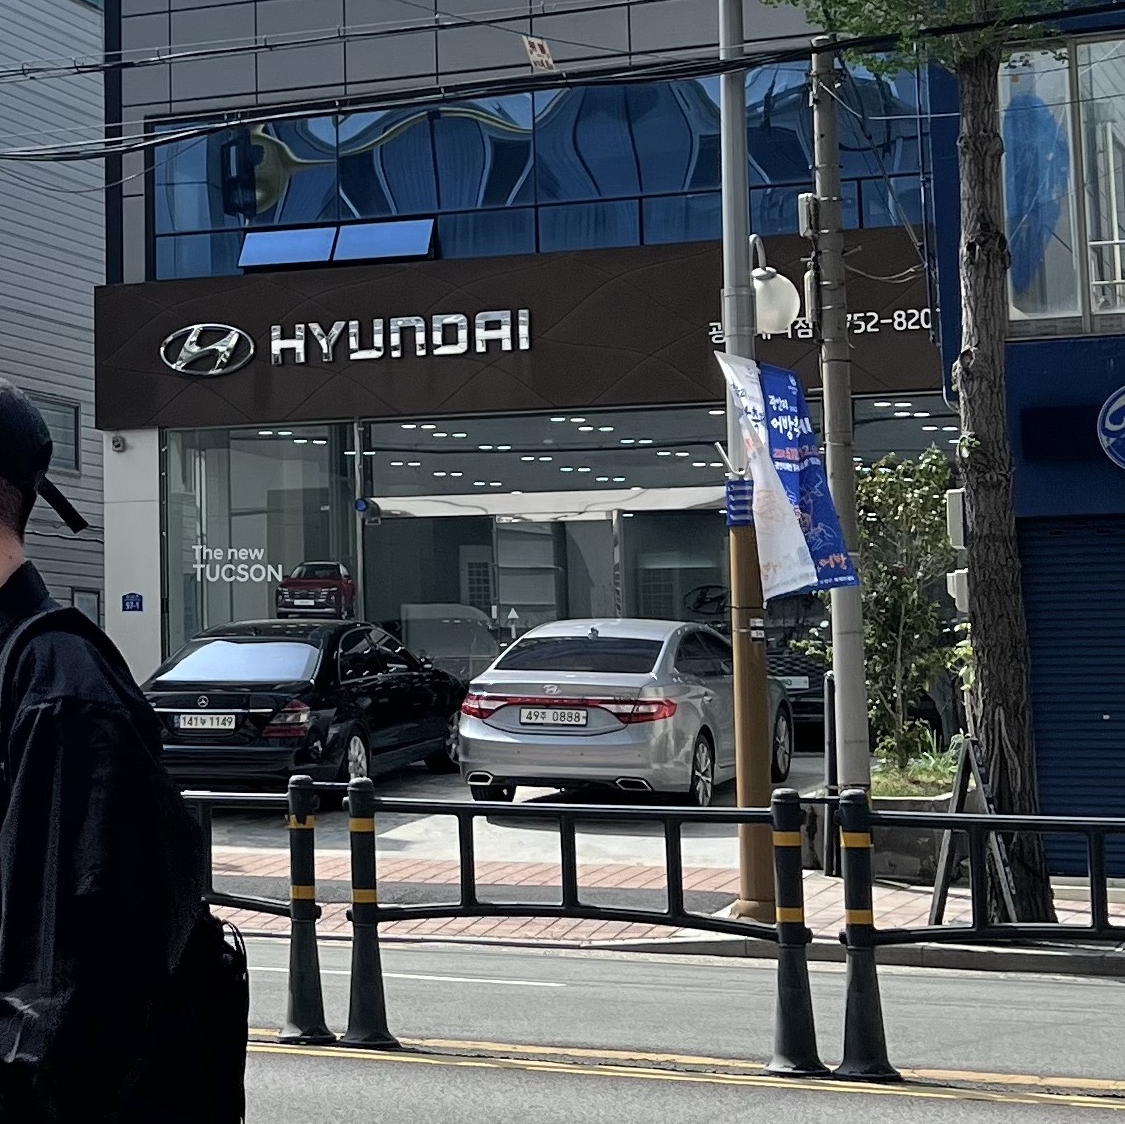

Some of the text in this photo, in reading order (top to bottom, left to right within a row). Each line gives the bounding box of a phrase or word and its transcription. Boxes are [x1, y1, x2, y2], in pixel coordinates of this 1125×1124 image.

[270, 308, 531, 365] HYUNDAI
[191, 545, 264, 560] The new
[192, 563, 283, 582] TUCSON
[209, 716, 233, 726] 1149
